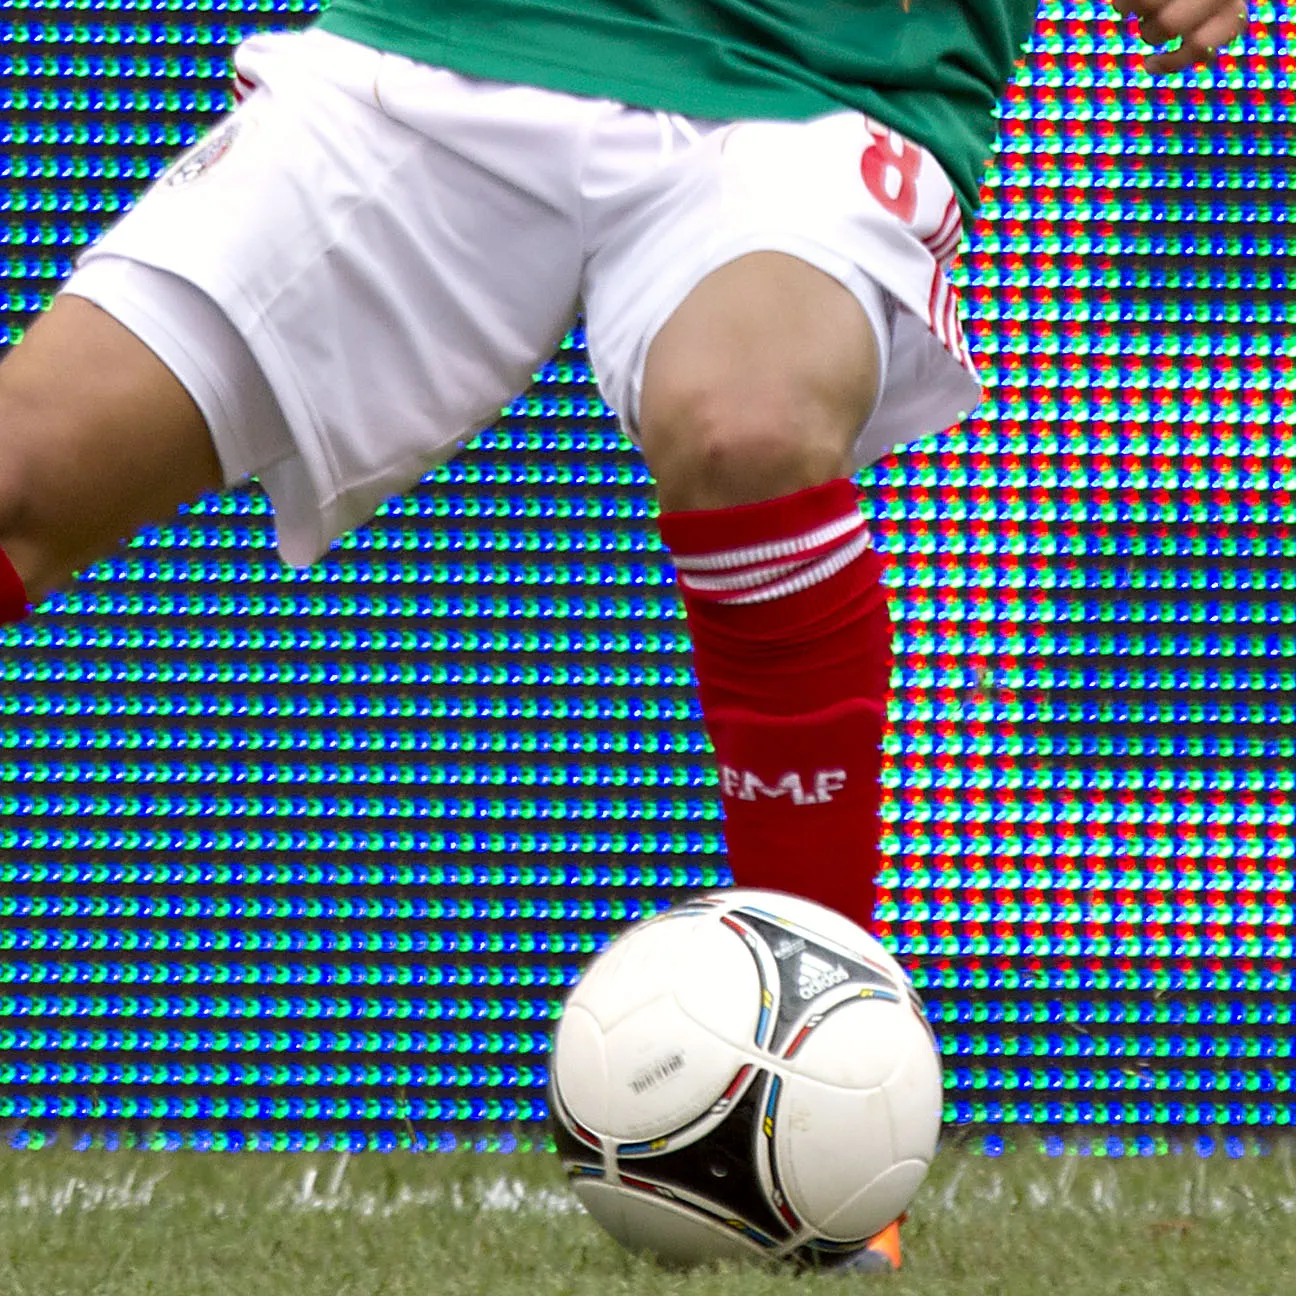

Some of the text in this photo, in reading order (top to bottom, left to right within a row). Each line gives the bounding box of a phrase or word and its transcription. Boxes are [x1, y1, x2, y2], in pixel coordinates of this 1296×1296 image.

[860, 115, 922, 224] 8
[721, 764, 847, 805] FMF
[799, 963, 849, 1000] adidas
